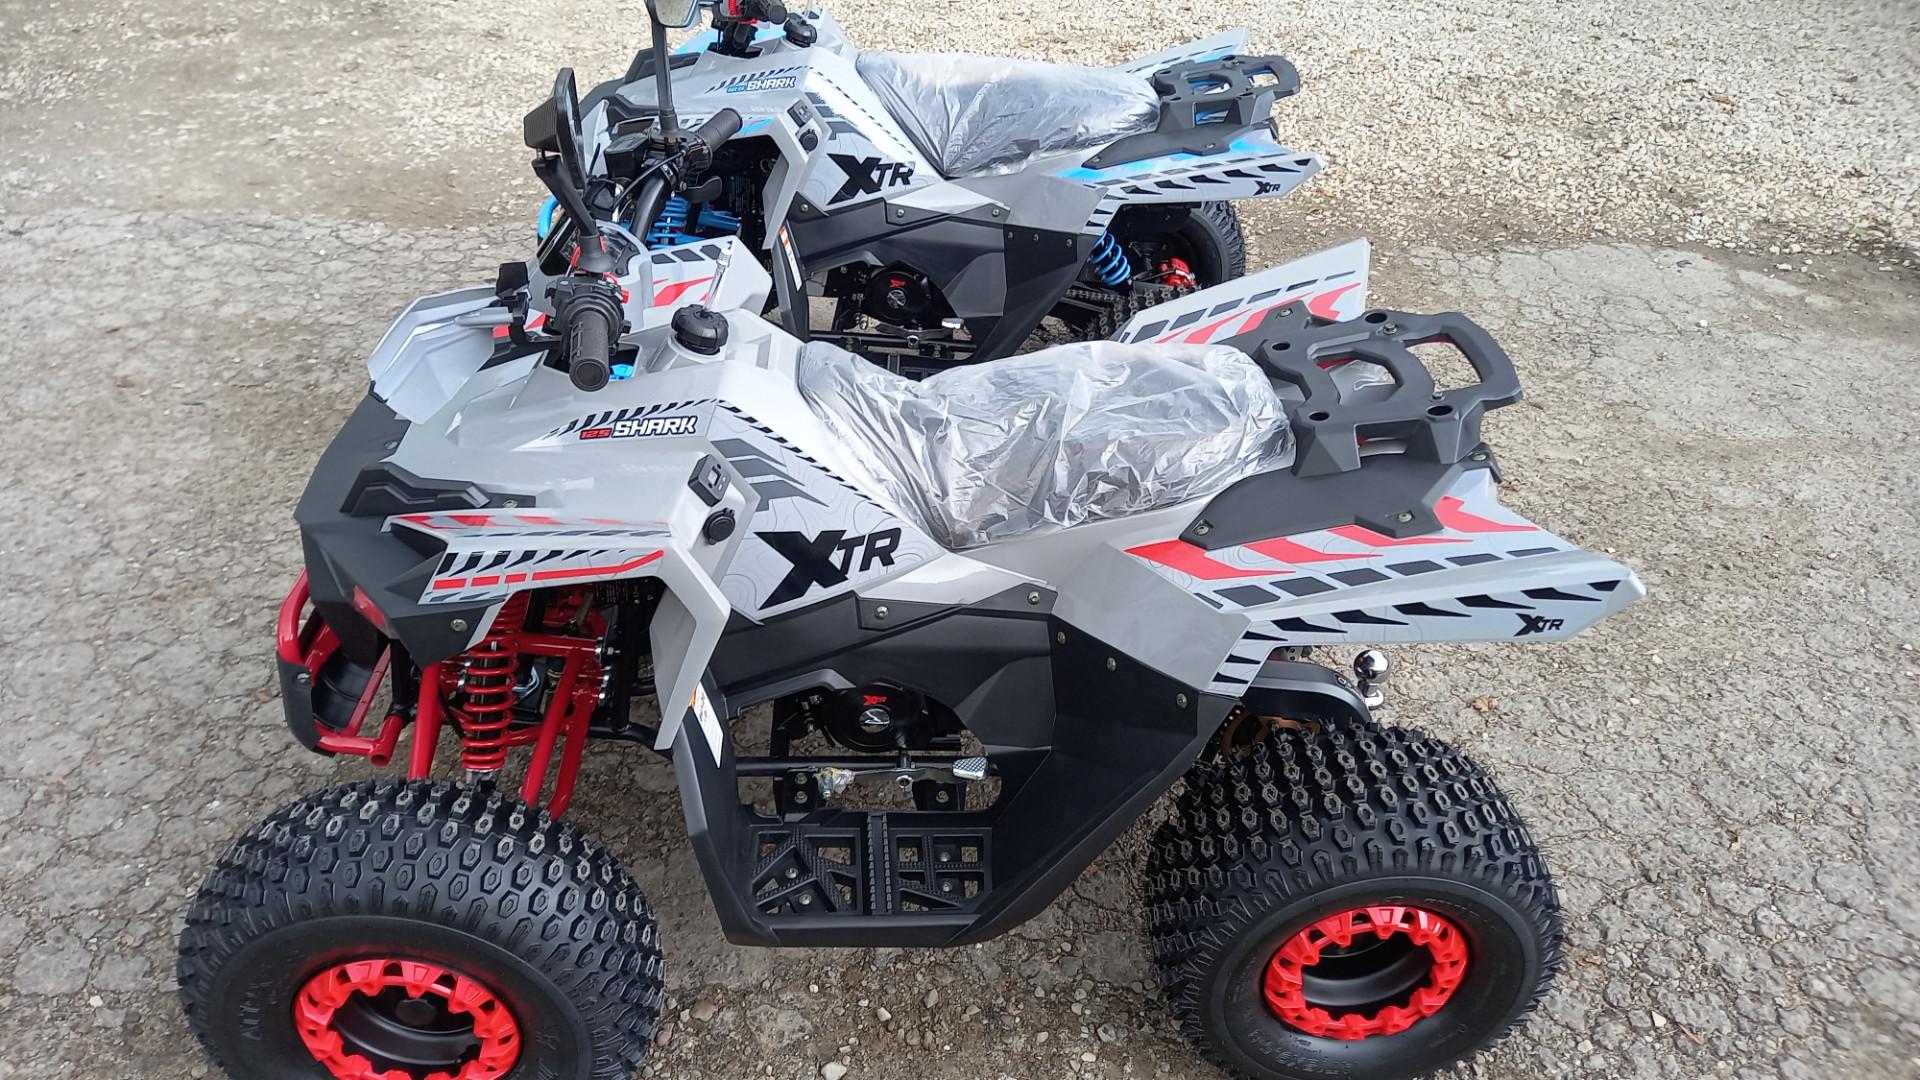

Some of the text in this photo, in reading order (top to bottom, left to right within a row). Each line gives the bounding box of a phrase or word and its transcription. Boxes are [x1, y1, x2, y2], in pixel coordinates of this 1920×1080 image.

[746, 77, 796, 91] SHARK
[826, 153, 915, 205] XTR
[1253, 180, 1281, 196] XTR
[580, 416, 697, 439] 125 SHARK
[753, 527, 901, 610] XTR
[1513, 613, 1564, 637] XTR
